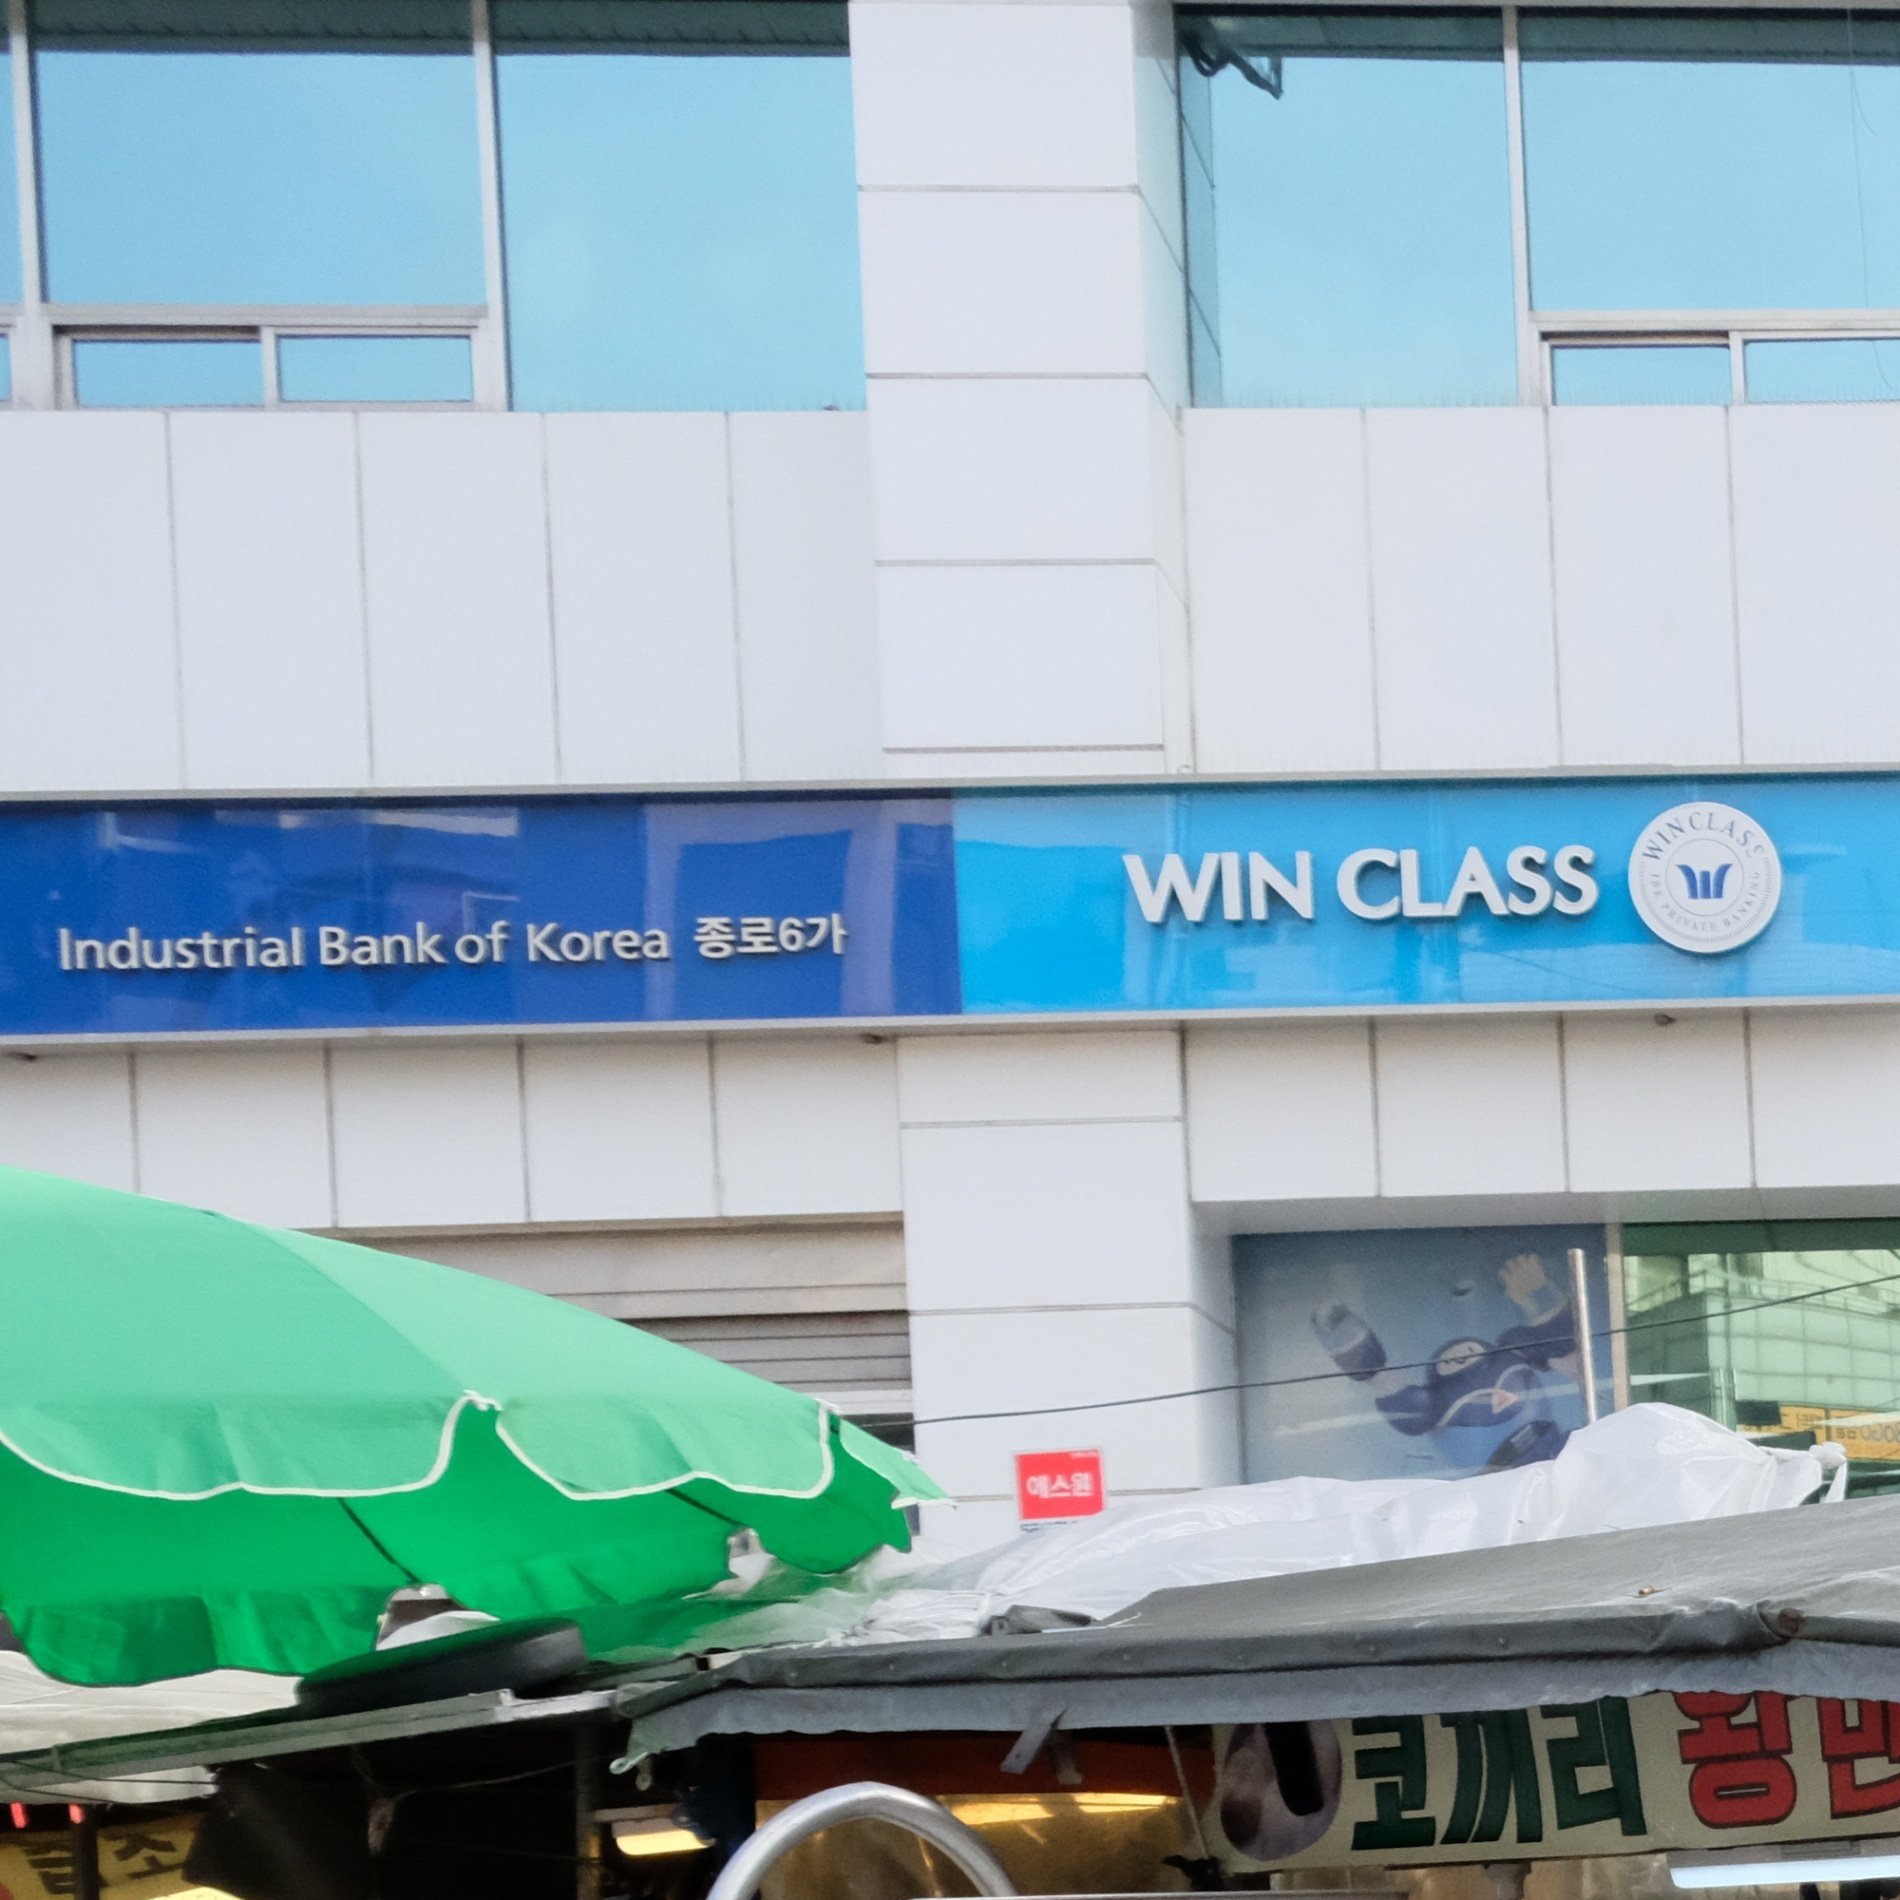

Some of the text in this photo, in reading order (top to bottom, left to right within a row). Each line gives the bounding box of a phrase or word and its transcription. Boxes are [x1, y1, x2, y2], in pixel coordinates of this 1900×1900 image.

[1123, 844, 1600, 923] WIN CLASS
[58, 913, 850, 971] Industrial Bank of Korea 종로6가
[1350, 1696, 1648, 1852] 코끼리
